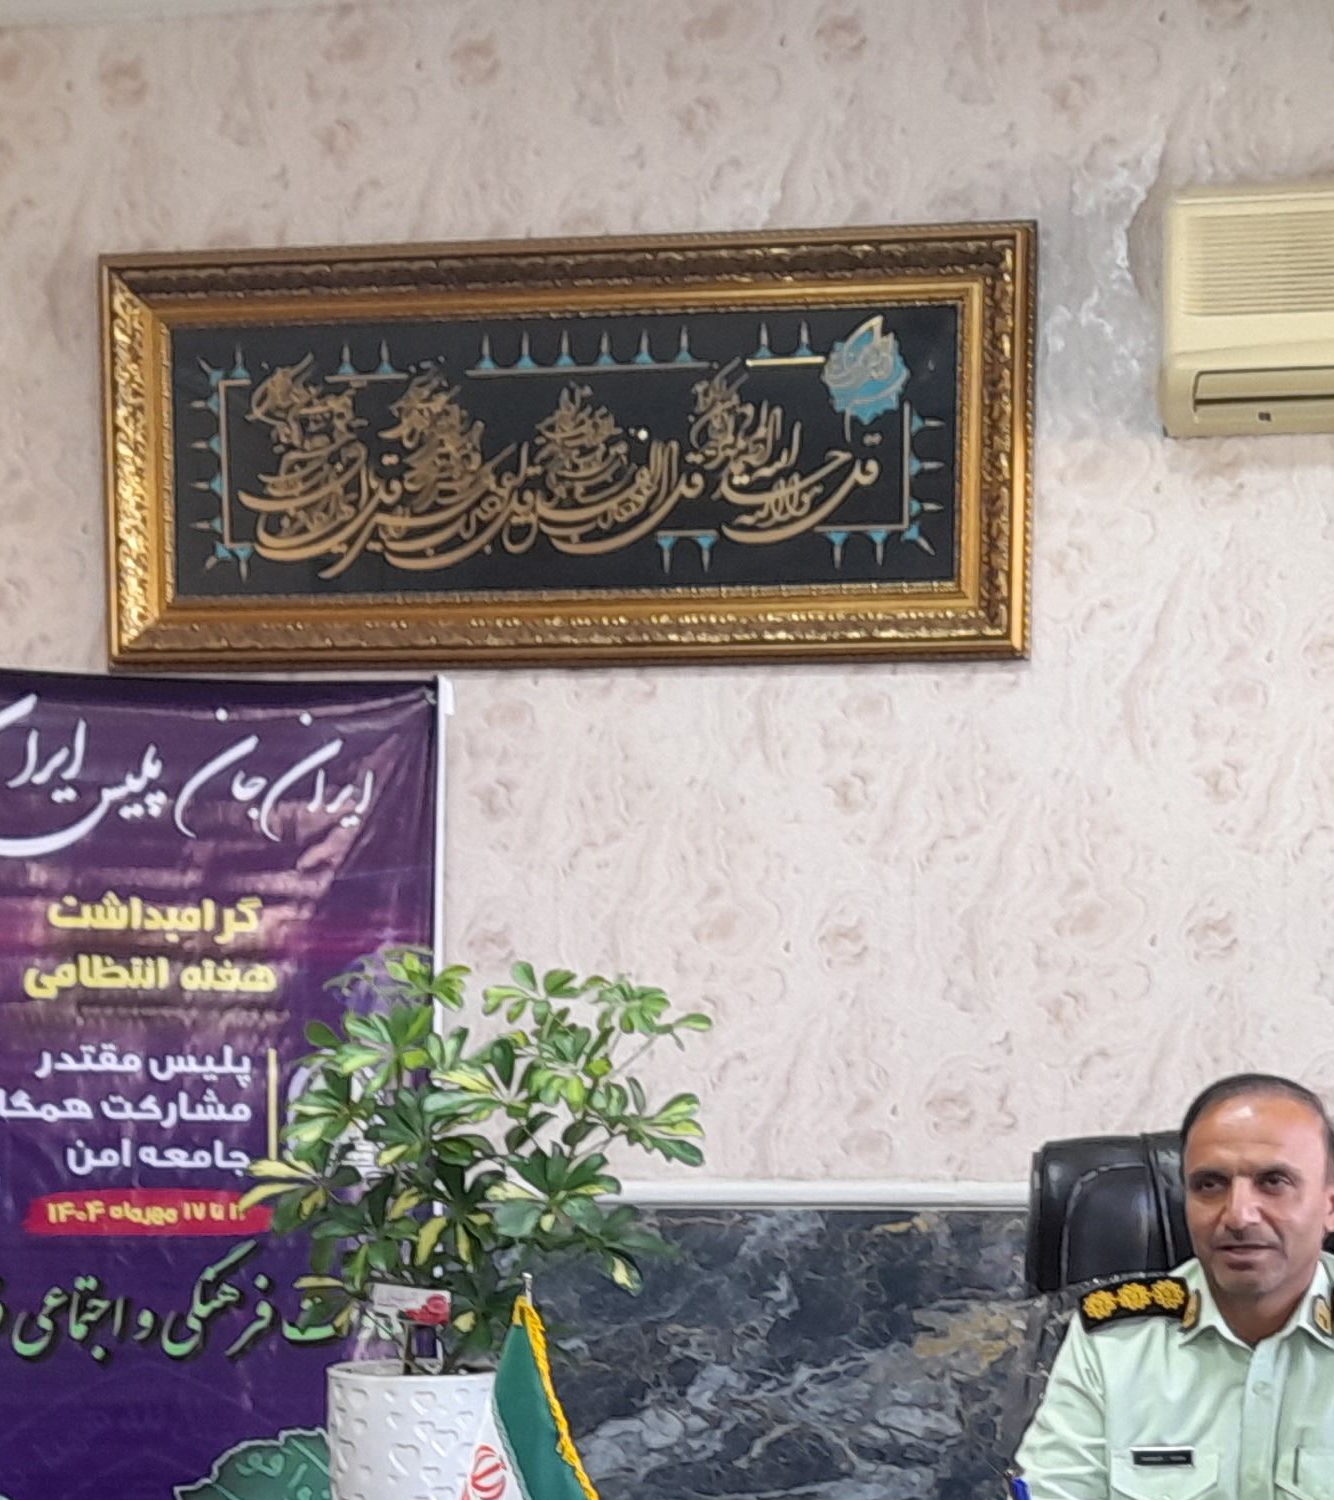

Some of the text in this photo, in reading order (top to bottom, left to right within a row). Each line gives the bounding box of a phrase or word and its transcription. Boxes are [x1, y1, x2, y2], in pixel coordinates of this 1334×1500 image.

[174, 708, 267, 839] جان
[261, 711, 375, 842] ایران
[23, 955, 277, 1000] هفته انتظامی
[35, 1044, 252, 1088] پلیس مقتدر
[100, 1089, 252, 1129] مشارکت
[67, 1138, 252, 1177] جامعه امن
[47, 1200, 105, 1224] ۱۴۰۴
[183, 1201, 206, 1221] ۱۷
[12, 1274, 126, 1365] اجتماعی
[161, 1240, 277, 1363] فرهنگی
[131, 1308, 155, 1345] و
